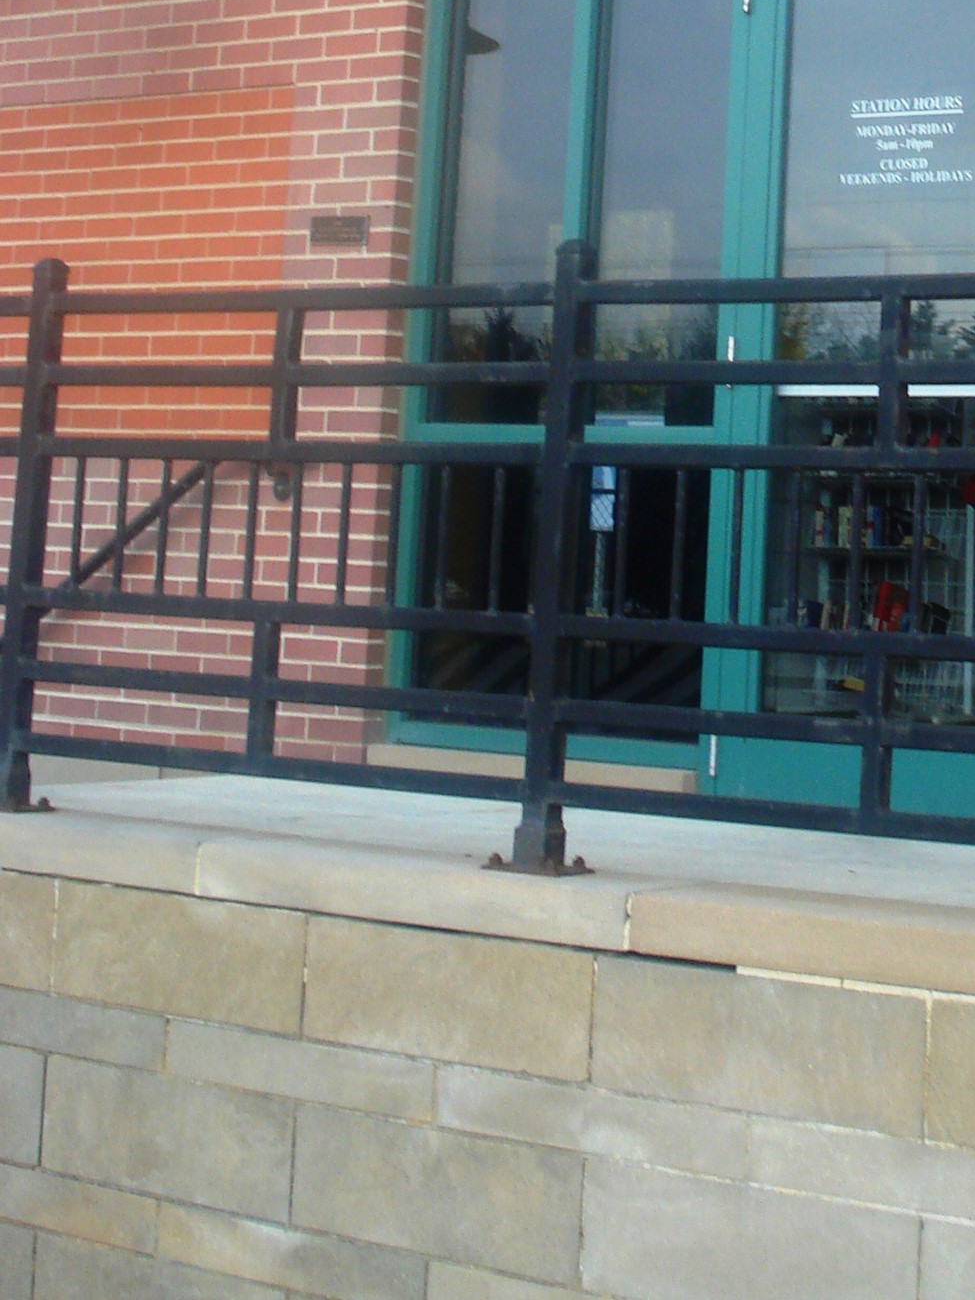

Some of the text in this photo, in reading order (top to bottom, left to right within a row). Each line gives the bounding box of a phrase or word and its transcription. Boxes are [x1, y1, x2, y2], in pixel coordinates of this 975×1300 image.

[851, 95, 963, 113] STATION HOURS
[879, 157, 929, 171] CLOSED
[910, 169, 974, 183] HOLIDAYS
